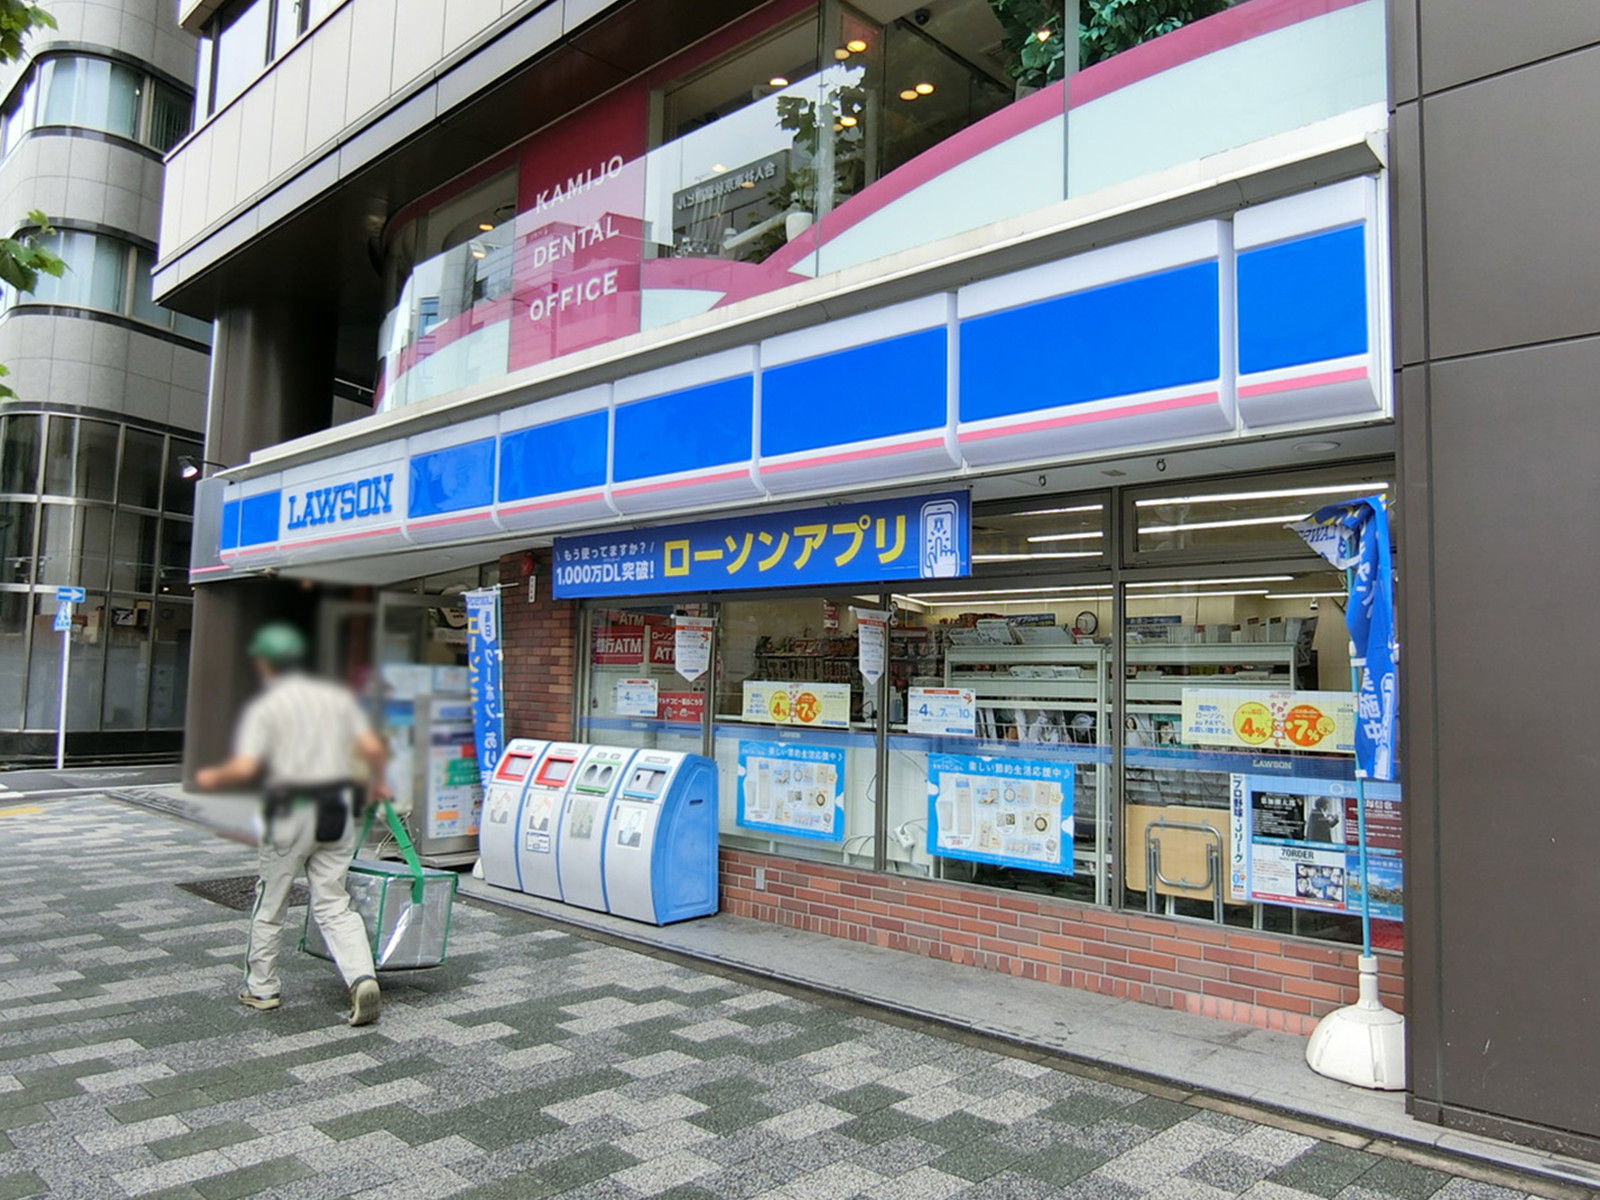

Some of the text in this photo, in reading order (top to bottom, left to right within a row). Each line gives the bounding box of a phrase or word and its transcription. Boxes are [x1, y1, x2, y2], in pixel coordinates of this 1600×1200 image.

[535, 154, 624, 214] KAMIJO
[533, 216, 619, 269] DENTAL
[529, 269, 618, 322] OFFICE
[287, 473, 394, 530] LAWSON
[664, 514, 906, 577] ローソンアプリ
[556, 560, 655, 586] 1,000万DL突破!
[618, 613, 645, 626] ATM
[654, 646, 675, 660] AT
[1240, 717, 1267, 738] 4%
[1293, 719, 1320, 741] 7%
[1252, 759, 1292, 769] LAWSON
